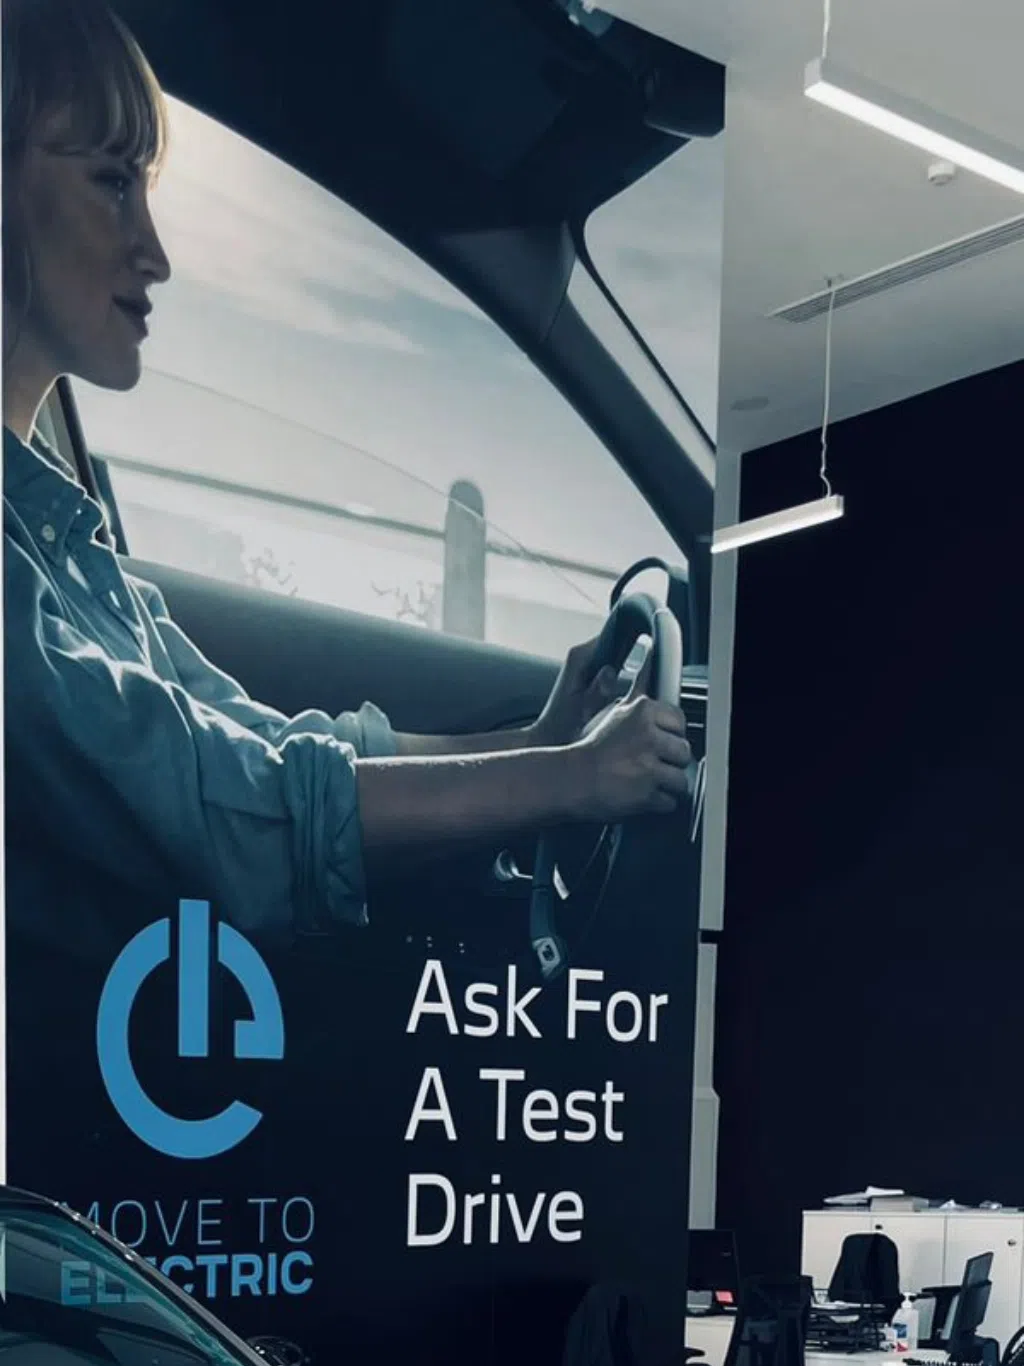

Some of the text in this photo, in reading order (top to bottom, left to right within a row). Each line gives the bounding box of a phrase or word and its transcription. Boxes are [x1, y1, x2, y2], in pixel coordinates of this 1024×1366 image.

[405, 959, 669, 1043] Ask For
[404, 1066, 625, 1142] A Test
[247, 1196, 315, 1243] TO
[407, 1172, 584, 1247] Drive
